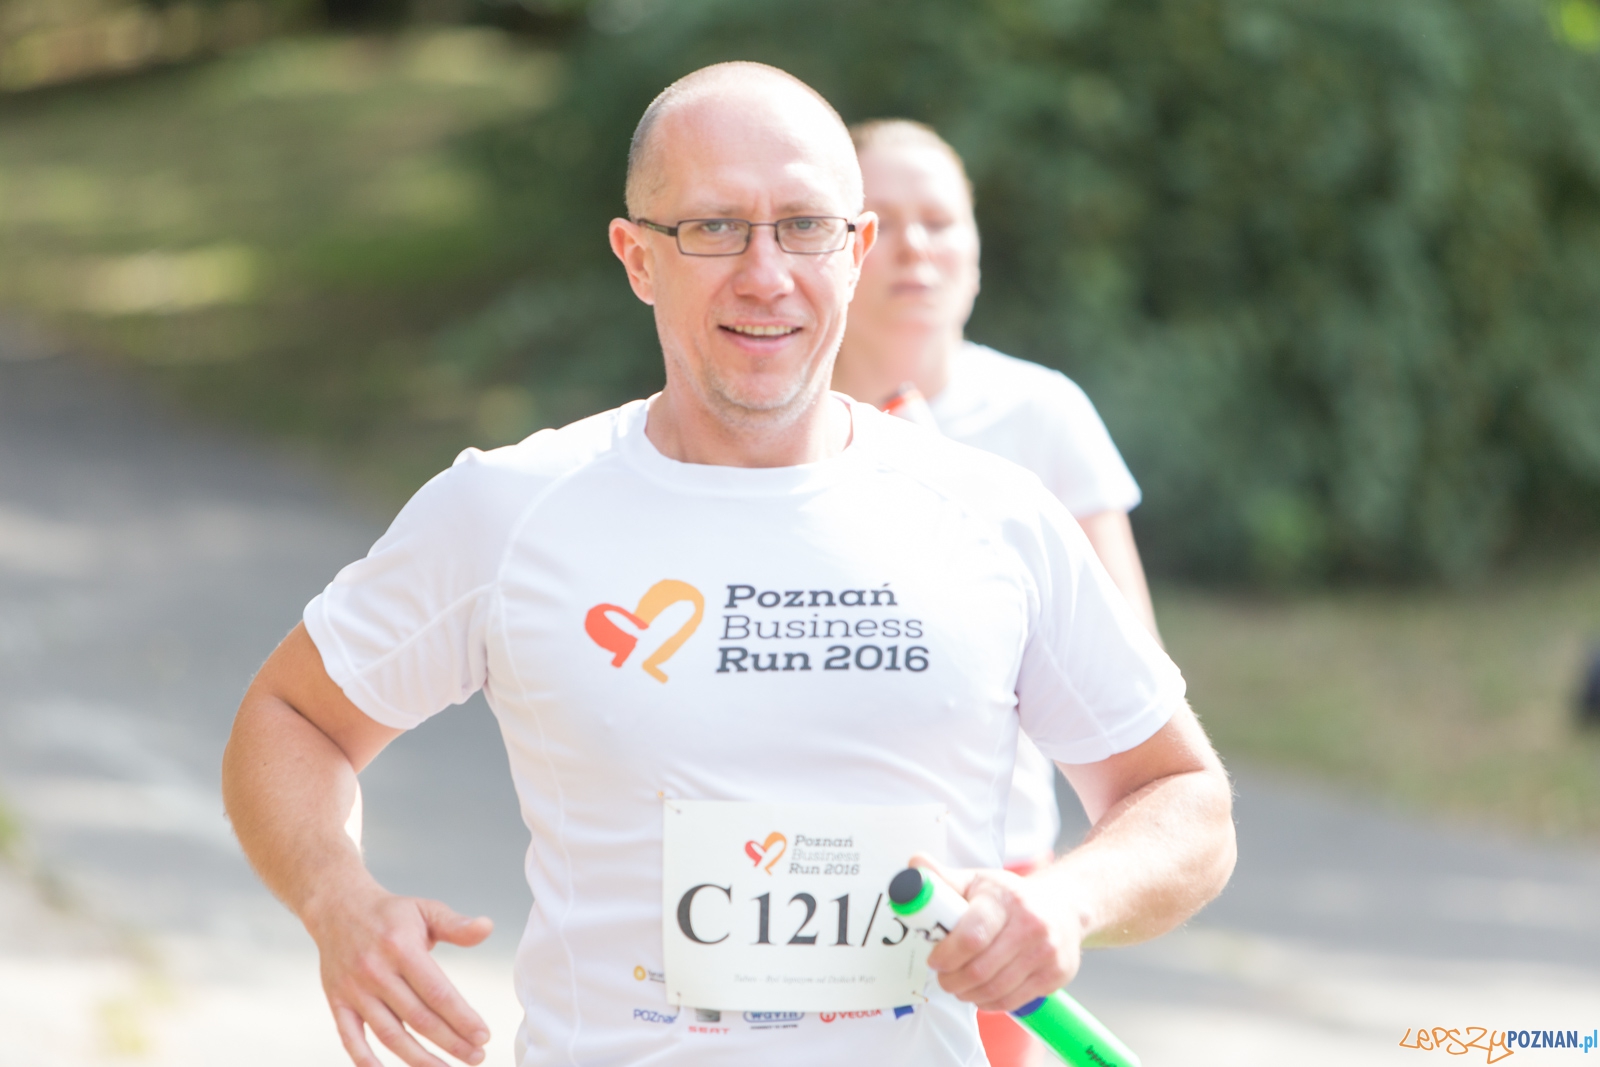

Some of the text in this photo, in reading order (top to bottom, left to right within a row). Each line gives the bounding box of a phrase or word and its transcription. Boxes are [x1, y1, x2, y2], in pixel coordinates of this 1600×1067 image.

[724, 582, 899, 609] Poznań
[720, 613, 924, 640] Business
[716, 645, 930, 673] Run 2016
[794, 834, 854, 848] Poznań
[791, 848, 861, 862] Business
[789, 862, 860, 876] Run 2016
[676, 883, 733, 945] C
[688, 1025, 731, 1035] SEAT
